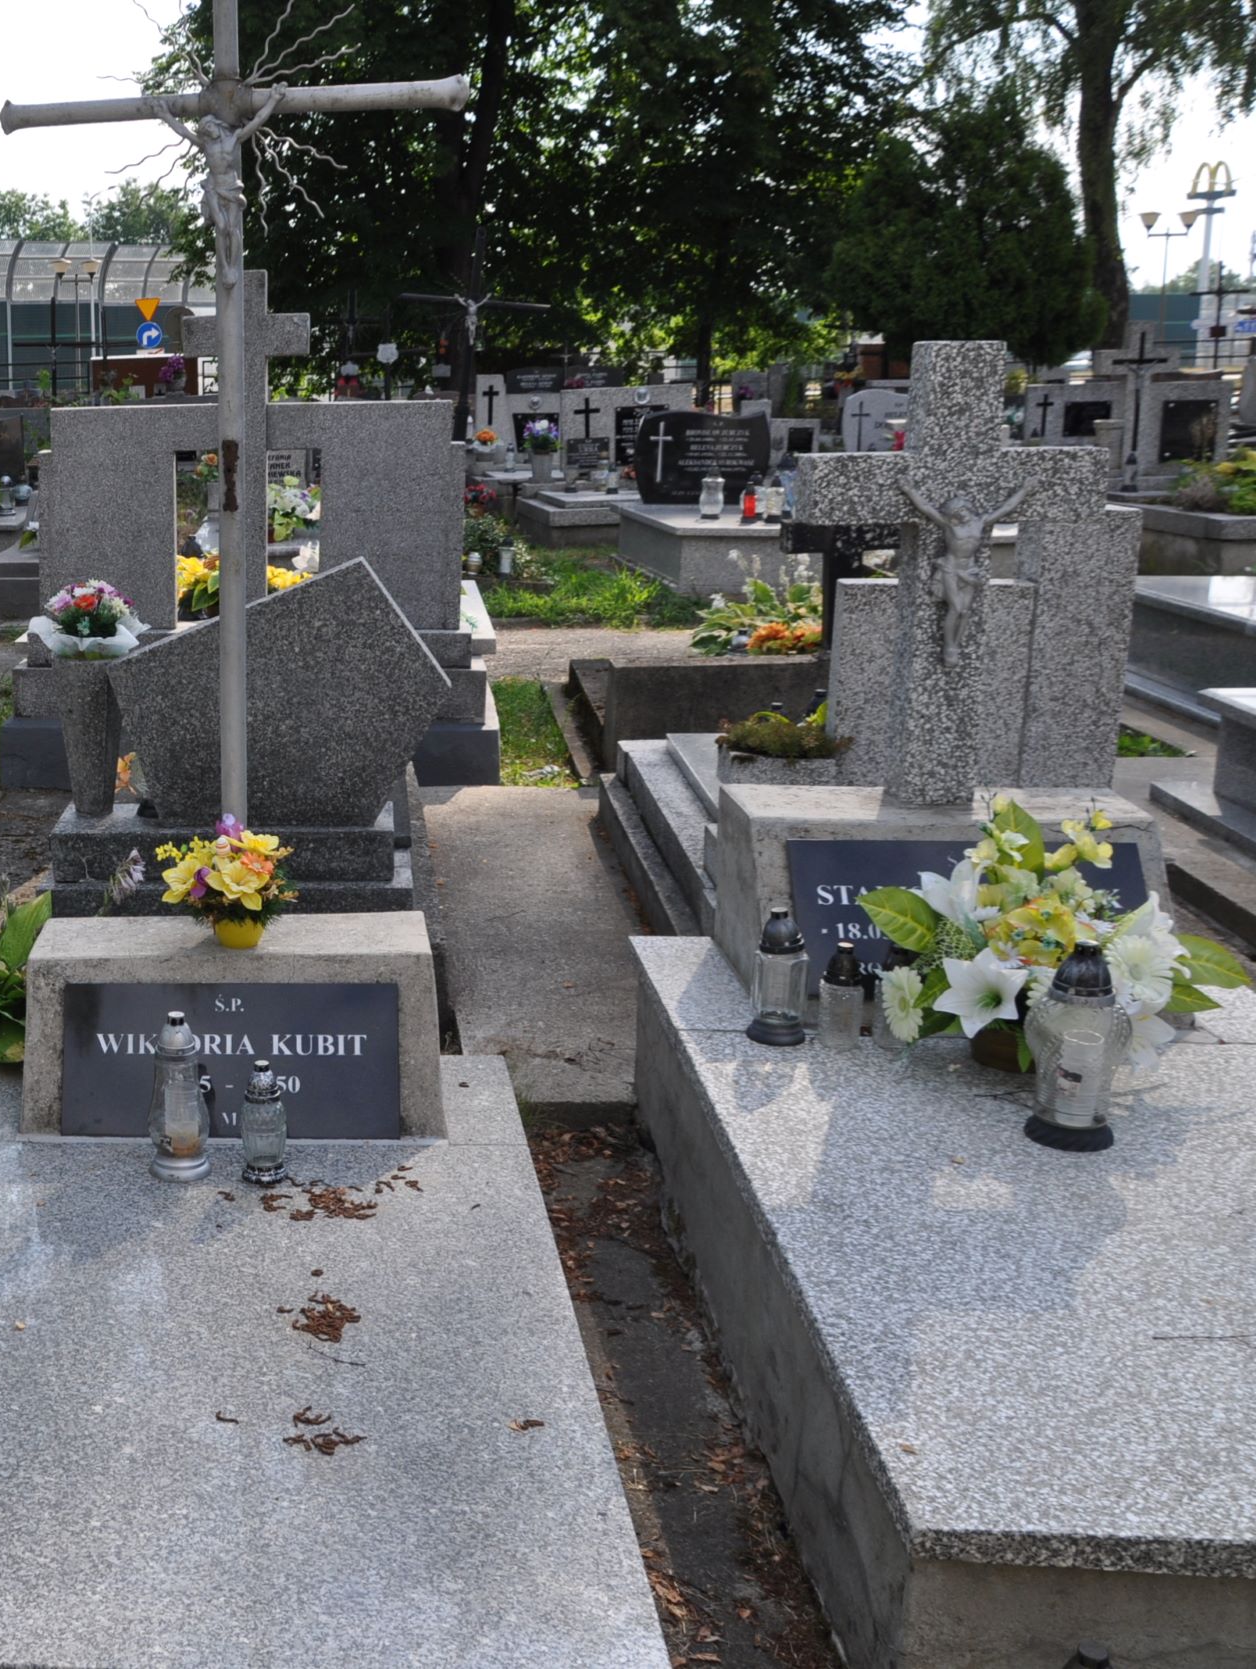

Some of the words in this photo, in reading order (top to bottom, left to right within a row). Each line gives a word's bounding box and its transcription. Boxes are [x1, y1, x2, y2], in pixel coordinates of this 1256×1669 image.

[214, 993, 245, 1013] Ś.P.
[96, 1033, 256, 1055] WIKRIA
[271, 1033, 368, 1056] KUBIT
